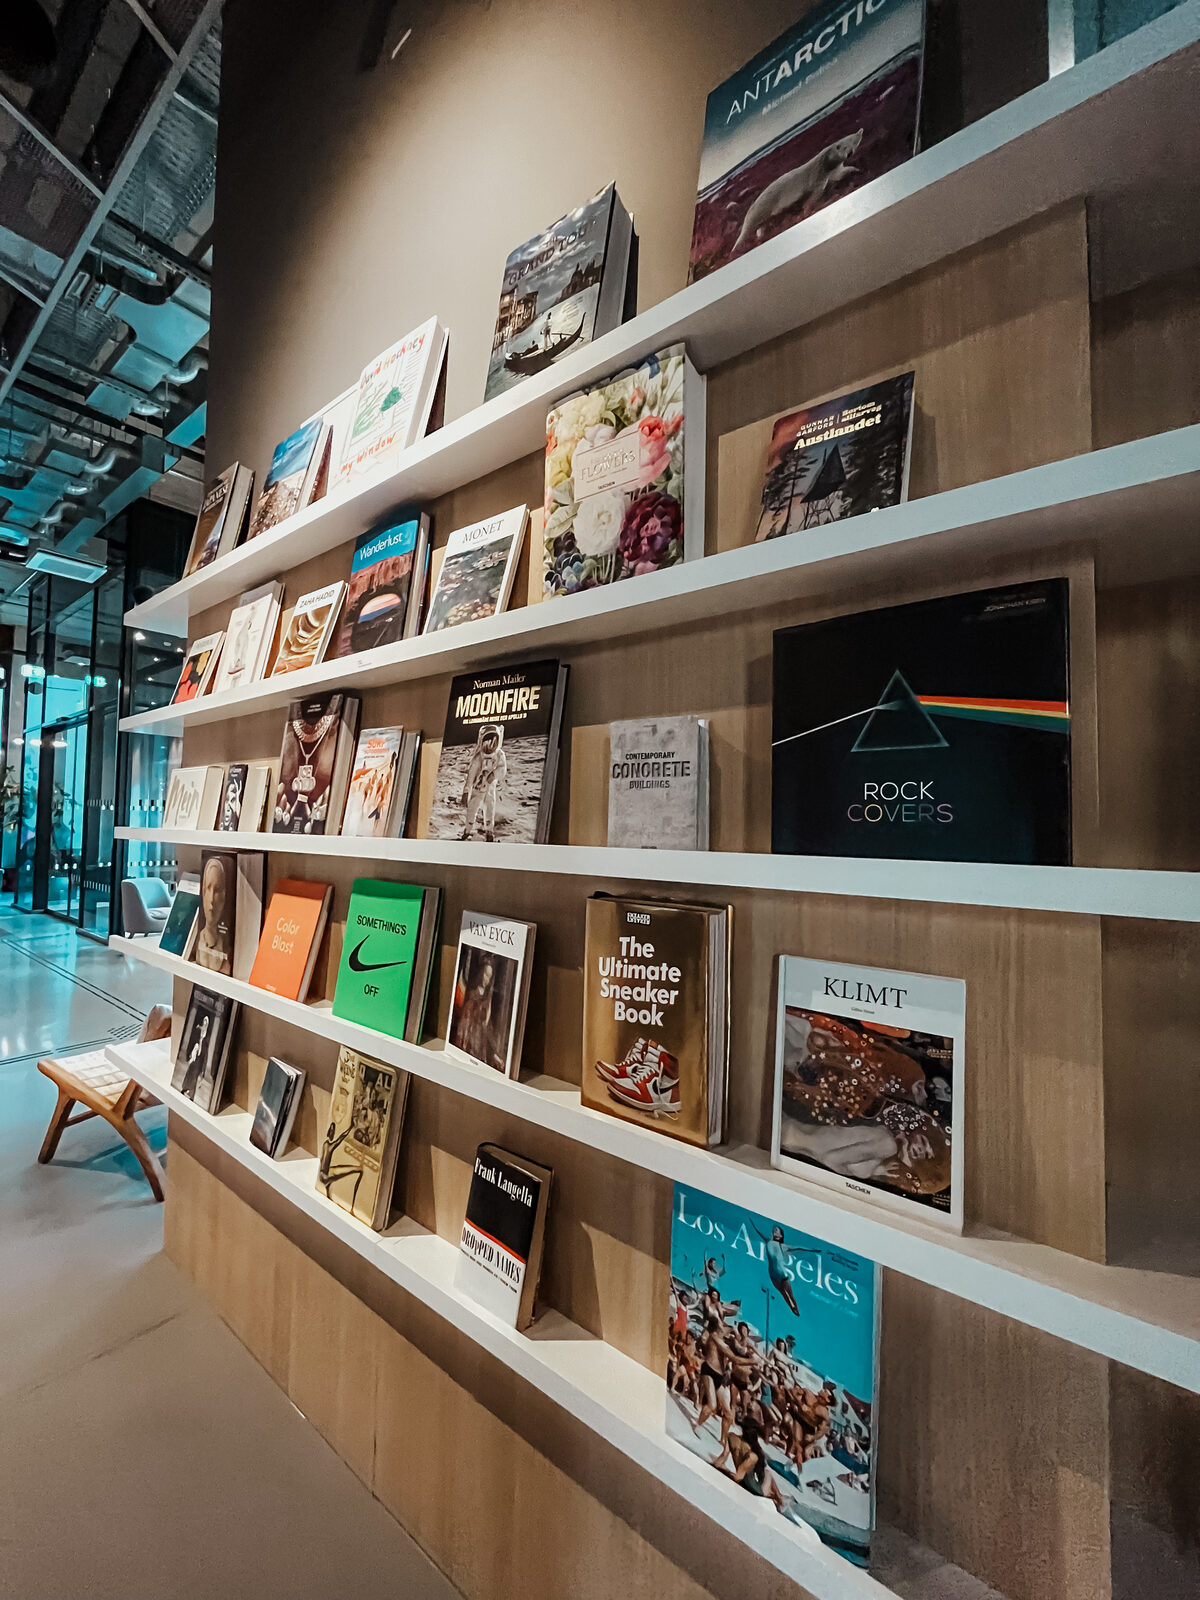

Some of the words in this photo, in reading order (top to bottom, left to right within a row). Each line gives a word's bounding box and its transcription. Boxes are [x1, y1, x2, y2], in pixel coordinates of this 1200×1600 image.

[509, 248, 555, 286] GRAND
[793, 413, 882, 451] Austlandet
[796, 421, 834, 438] GARFORS
[801, 415, 835, 431] GUNNAR
[581, 450, 636, 480] FLOWERS
[462, 519, 505, 544] MONET
[359, 532, 403, 561] Wanderlust
[473, 679, 501, 690] Norman
[502, 673, 527, 686] Mailer
[455, 685, 541, 719] MOONFIRE
[625, 751, 676, 761] CONTEMPORARY
[612, 761, 691, 779] CONCRETE
[629, 780, 671, 790] BUILDINGS
[863, 780, 935, 801] ROCK
[847, 803, 954, 823] COVERS
[276, 917, 300, 935] Color
[356, 914, 408, 936] SOMETHING'S
[470, 920, 488, 937] VAN
[489, 926, 515, 946] EYCK
[271, 934, 294, 955] Blast
[618, 936, 655, 958] The
[598, 956, 682, 983] Ultimate
[363, 984, 380, 998] OFF
[600, 978, 679, 1005] Sneaker
[823, 976, 908, 1009] KLIMT
[614, 1001, 664, 1027] Book
[474, 1157, 497, 1185] Frank
[497, 1171, 533, 1208] Langella
[845, 1181, 871, 1195] TASCHEN
[677, 1192, 725, 1242] Los
[495, 1250, 522, 1284] NAMES
